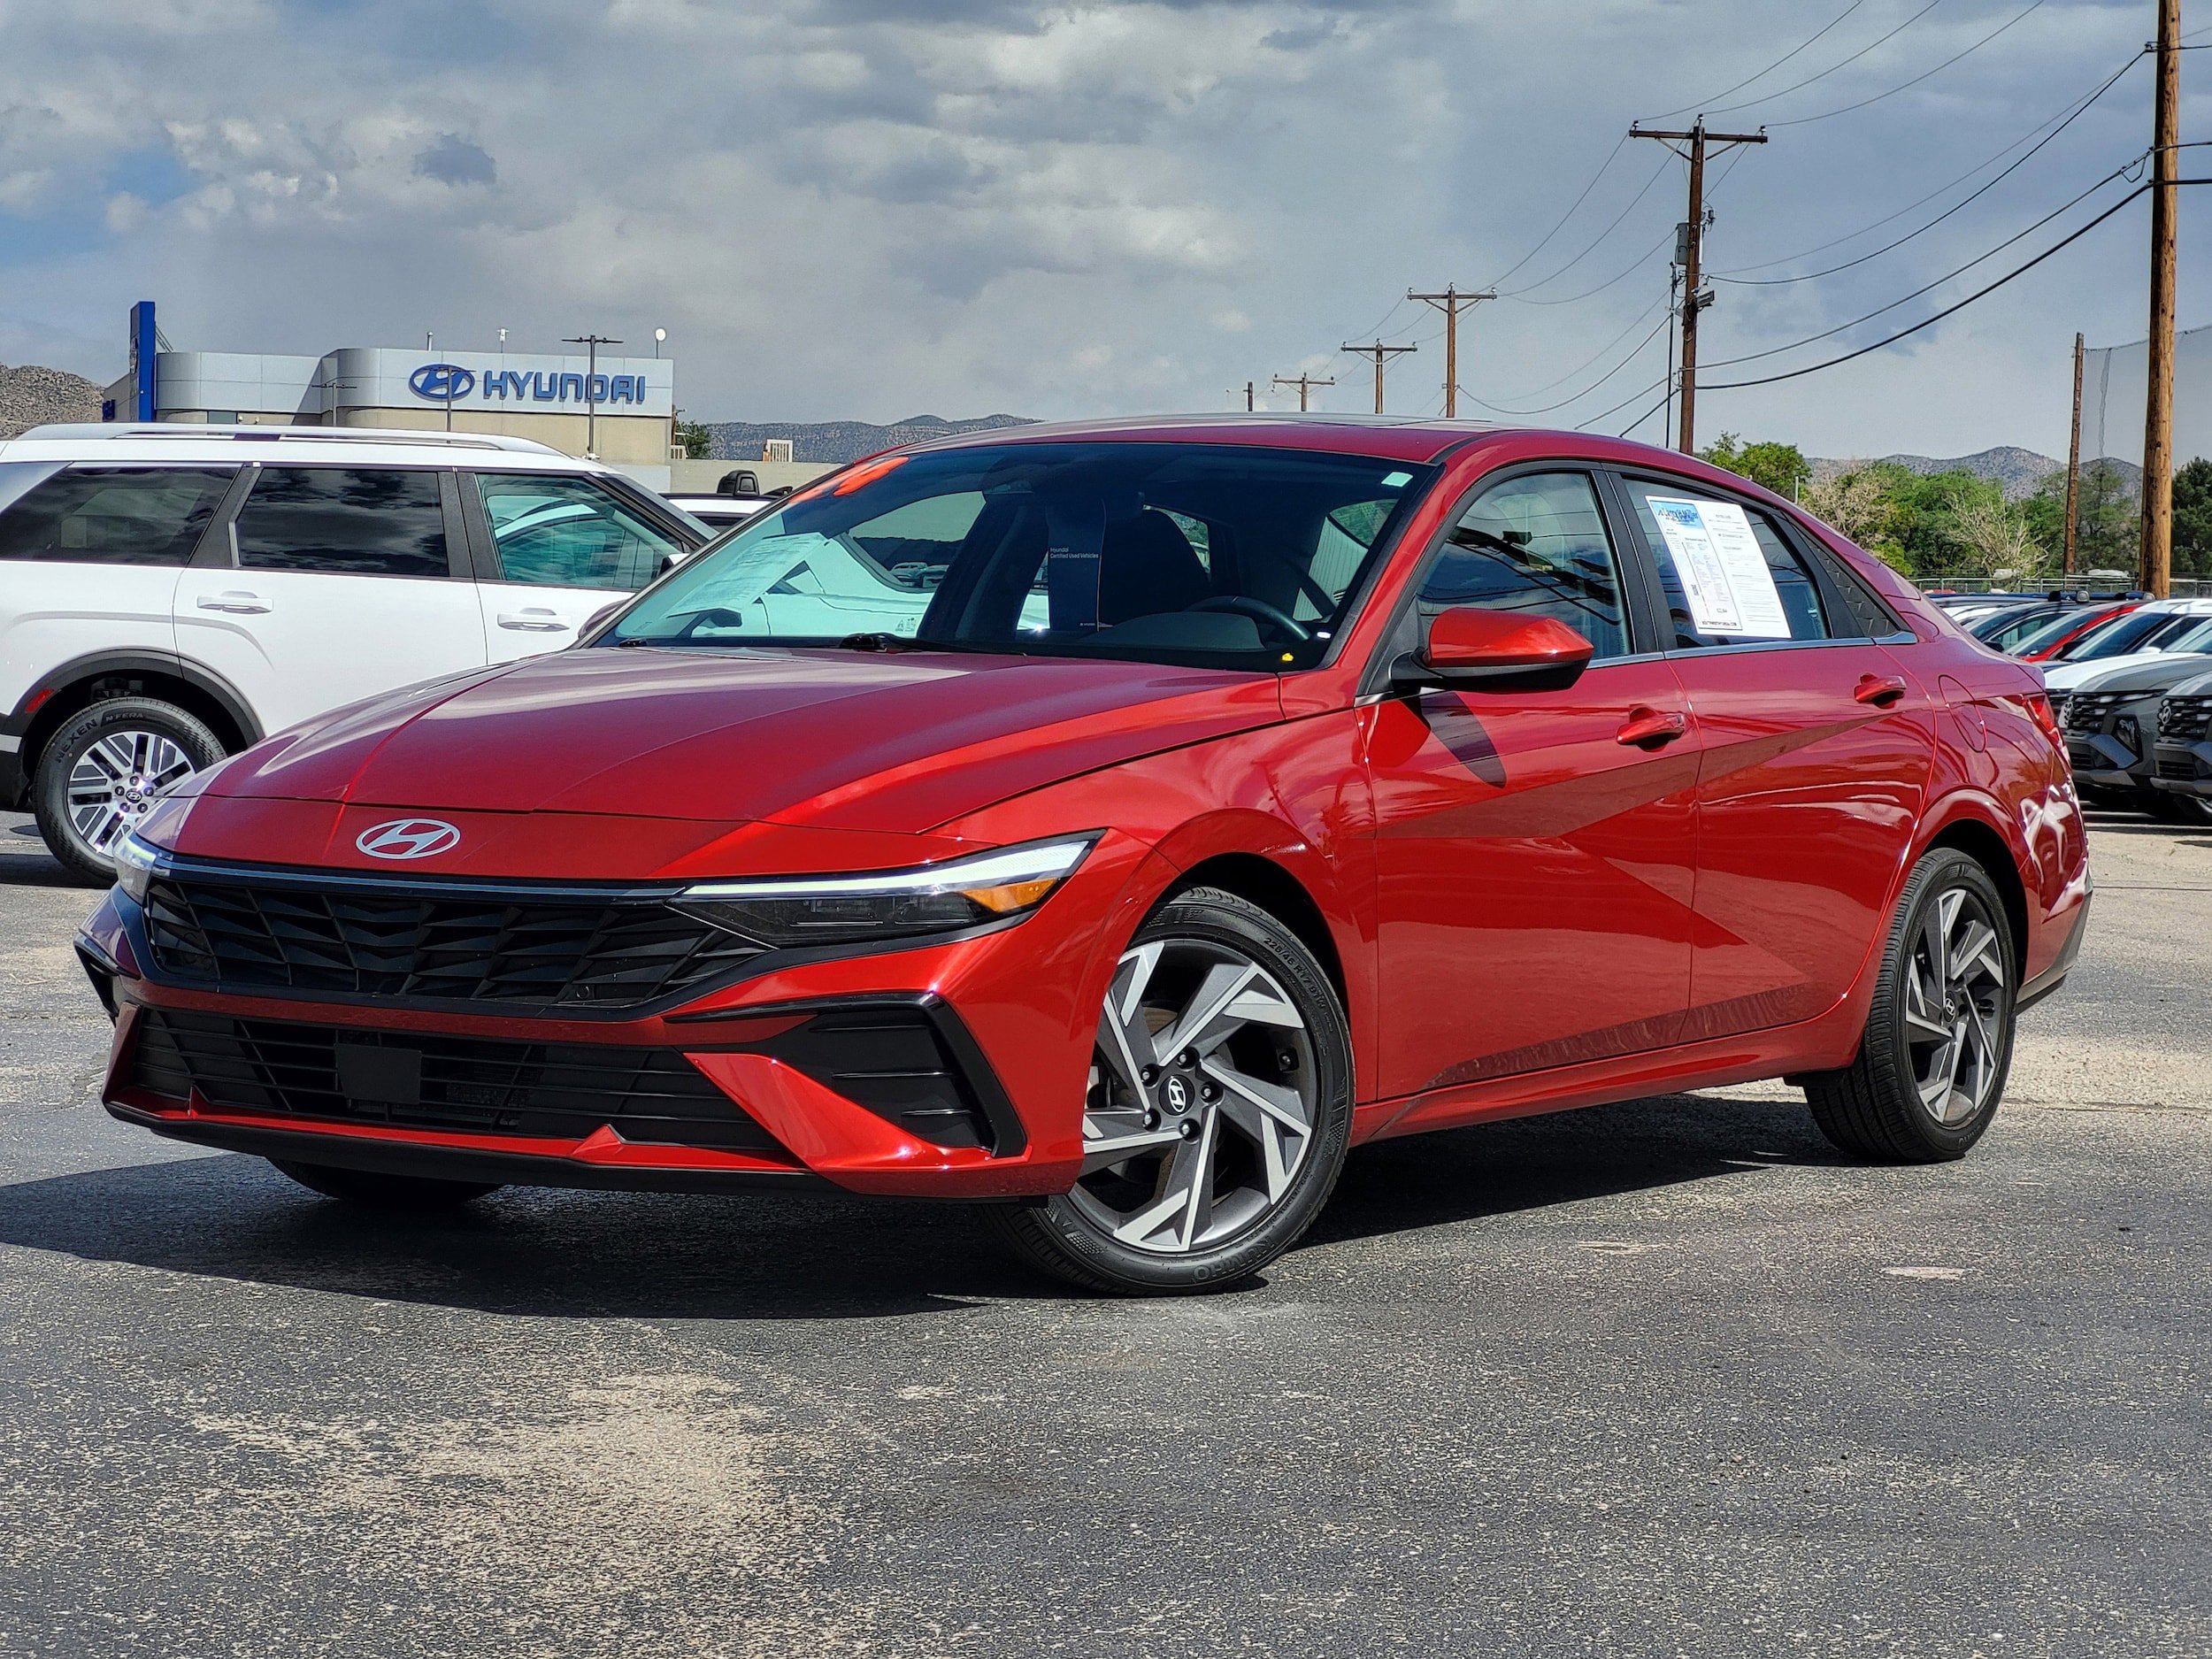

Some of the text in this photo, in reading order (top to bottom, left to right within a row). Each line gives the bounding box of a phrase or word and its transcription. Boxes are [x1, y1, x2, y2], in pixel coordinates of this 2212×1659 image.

[484, 370, 646, 404] HYUNDAI
[55, 718, 98, 764] NEXEN
[1195, 1234, 1276, 1280] KUMHO
